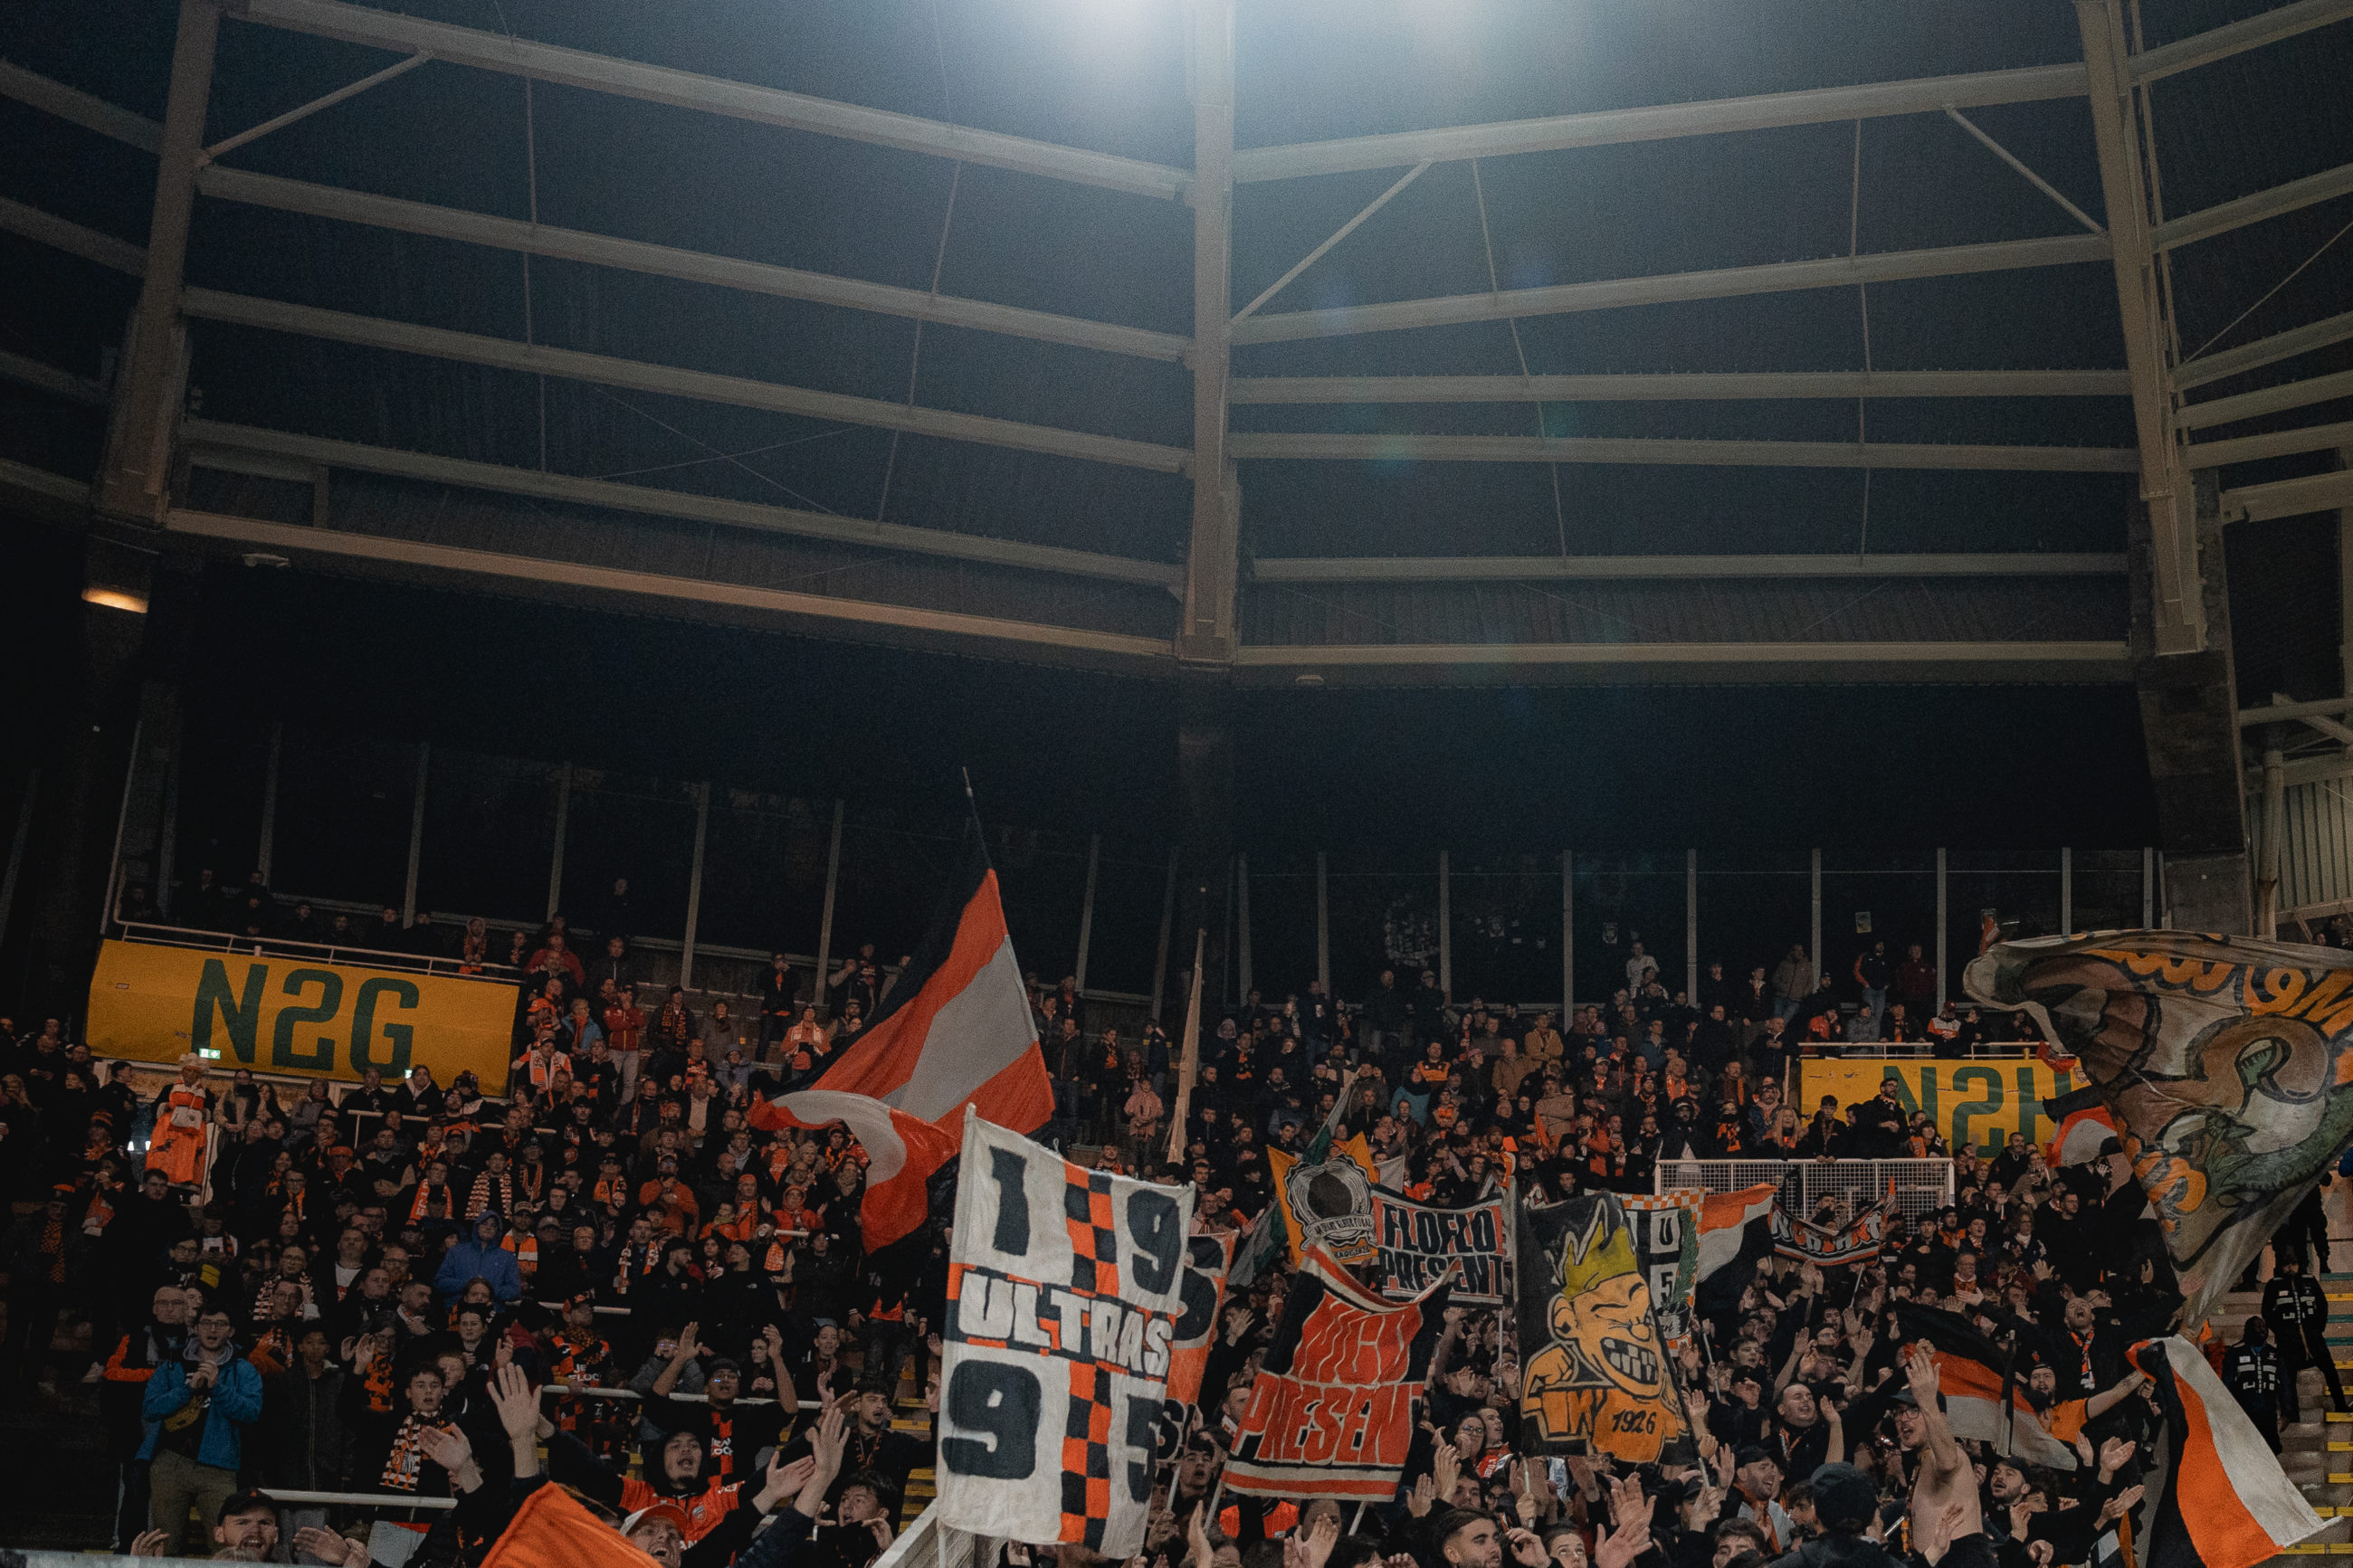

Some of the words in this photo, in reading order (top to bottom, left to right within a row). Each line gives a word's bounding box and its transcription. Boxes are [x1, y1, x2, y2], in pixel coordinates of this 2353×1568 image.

[191, 958, 420, 1080] N2G
[1383, 1202, 1497, 1255] FLOFLO
[957, 1269, 1174, 1378] ULTRAS
[1611, 1408, 1656, 1435] 1926
